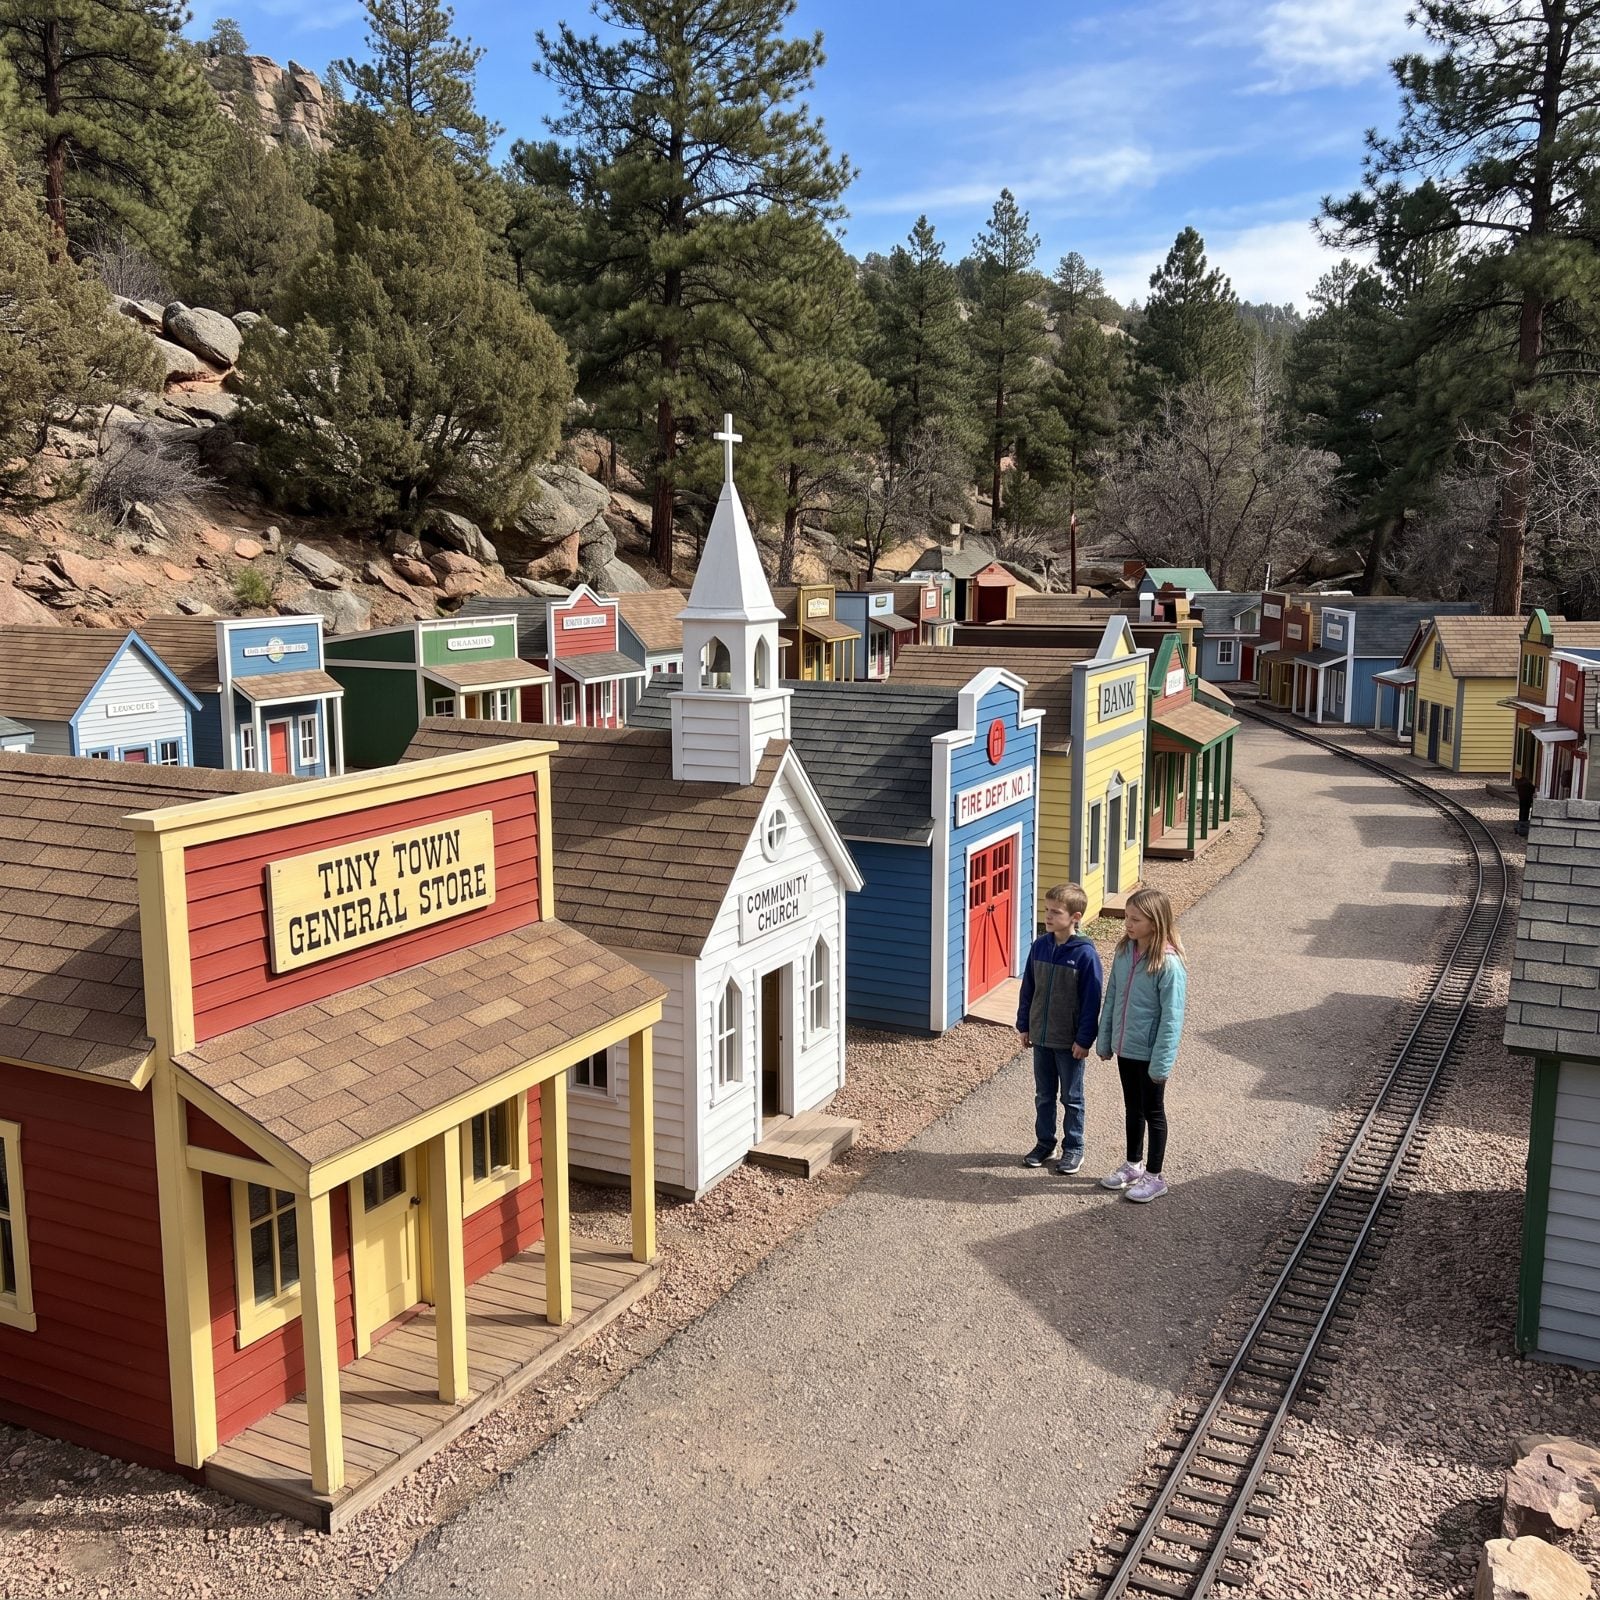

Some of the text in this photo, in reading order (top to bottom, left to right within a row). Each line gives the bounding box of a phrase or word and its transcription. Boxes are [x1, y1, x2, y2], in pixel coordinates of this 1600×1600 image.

[1103, 680, 1135, 715] BANK
[961, 773, 1031, 819] FIRE DEPT. NO. 1
[318, 829, 460, 899] TINY TOWN
[289, 863, 487, 956] GENERAL STORE
[747, 873, 808, 914] COMMUNITY
[758, 898, 799, 932] CHURCH
